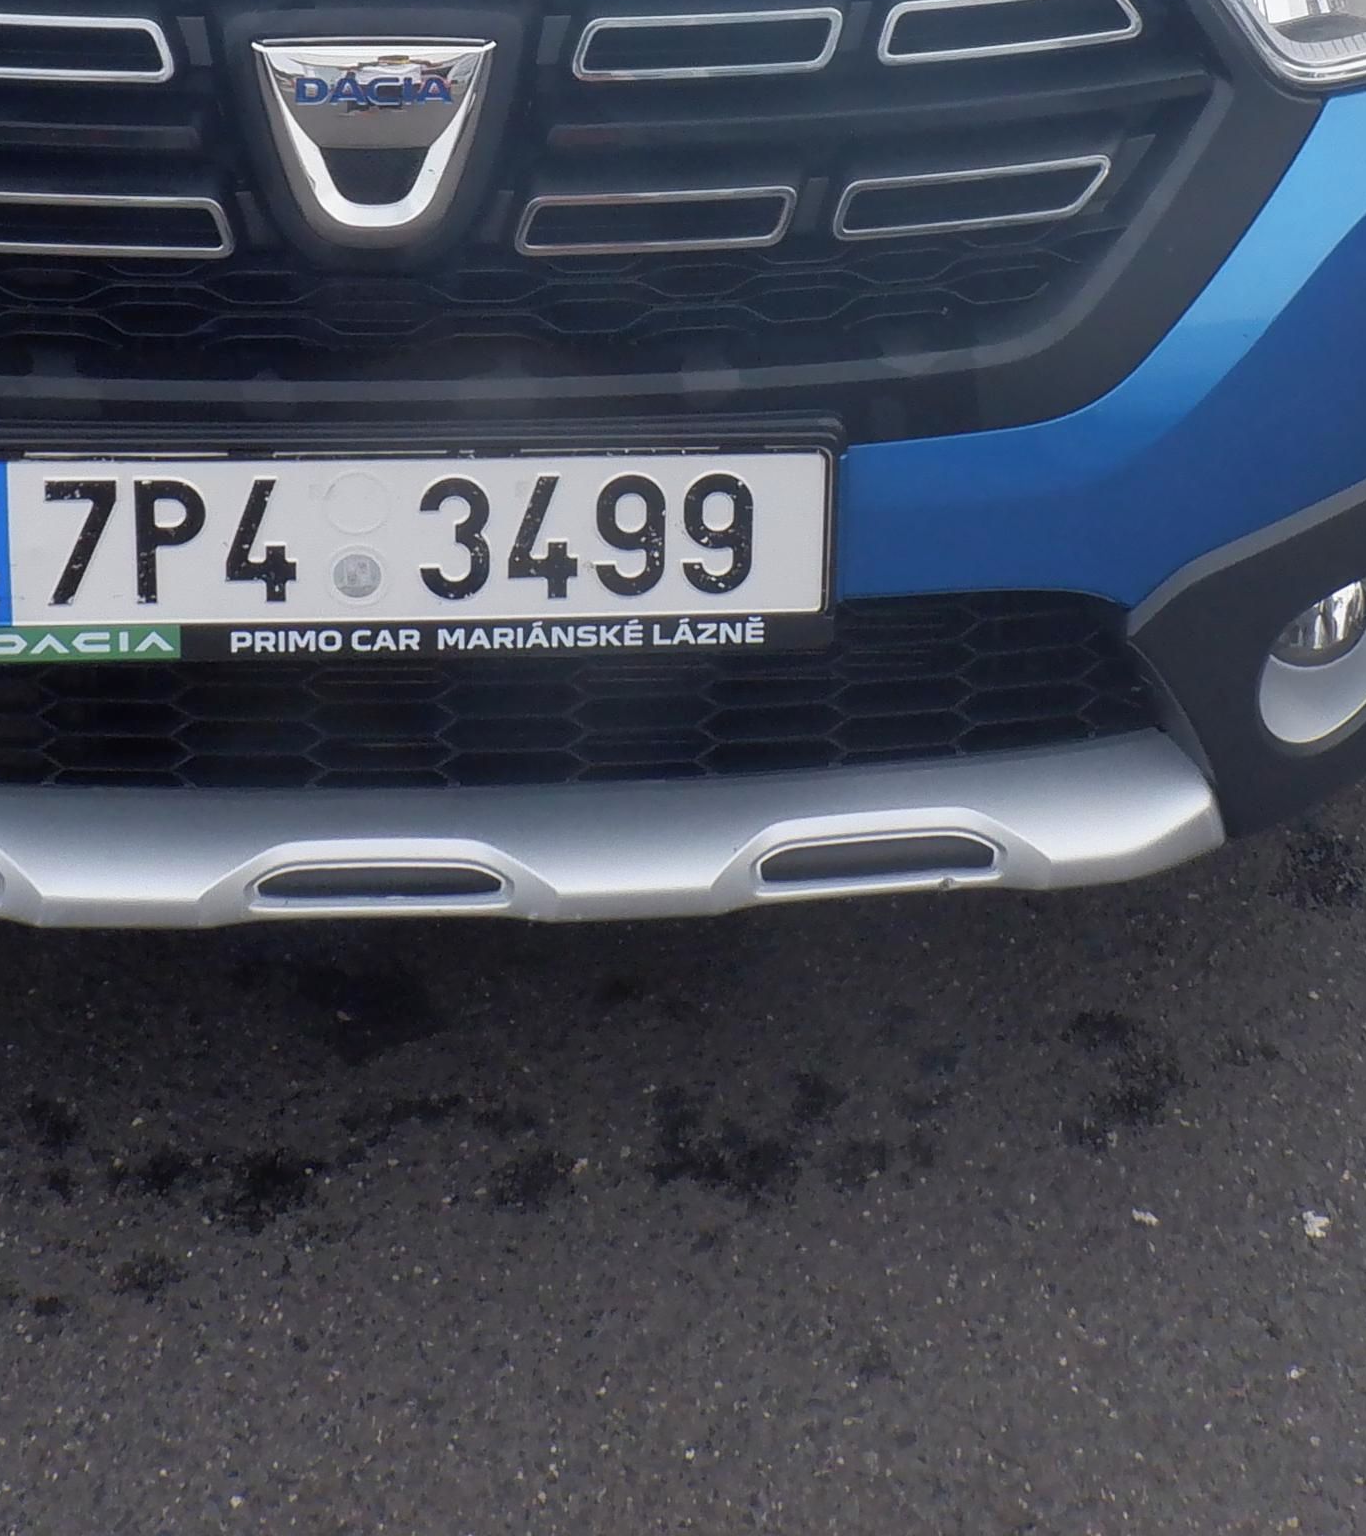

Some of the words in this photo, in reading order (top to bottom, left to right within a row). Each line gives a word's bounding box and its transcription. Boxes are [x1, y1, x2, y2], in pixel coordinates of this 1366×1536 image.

[295, 75, 454, 106] DACIA
[44, 477, 297, 606] 7P4
[419, 472, 754, 600] 3499
[230, 630, 342, 653] PRIMO
[351, 629, 420, 652] CAR
[437, 617, 645, 651] MARIÁNSKÉ
[652, 616, 766, 647] LÁZNĚ
